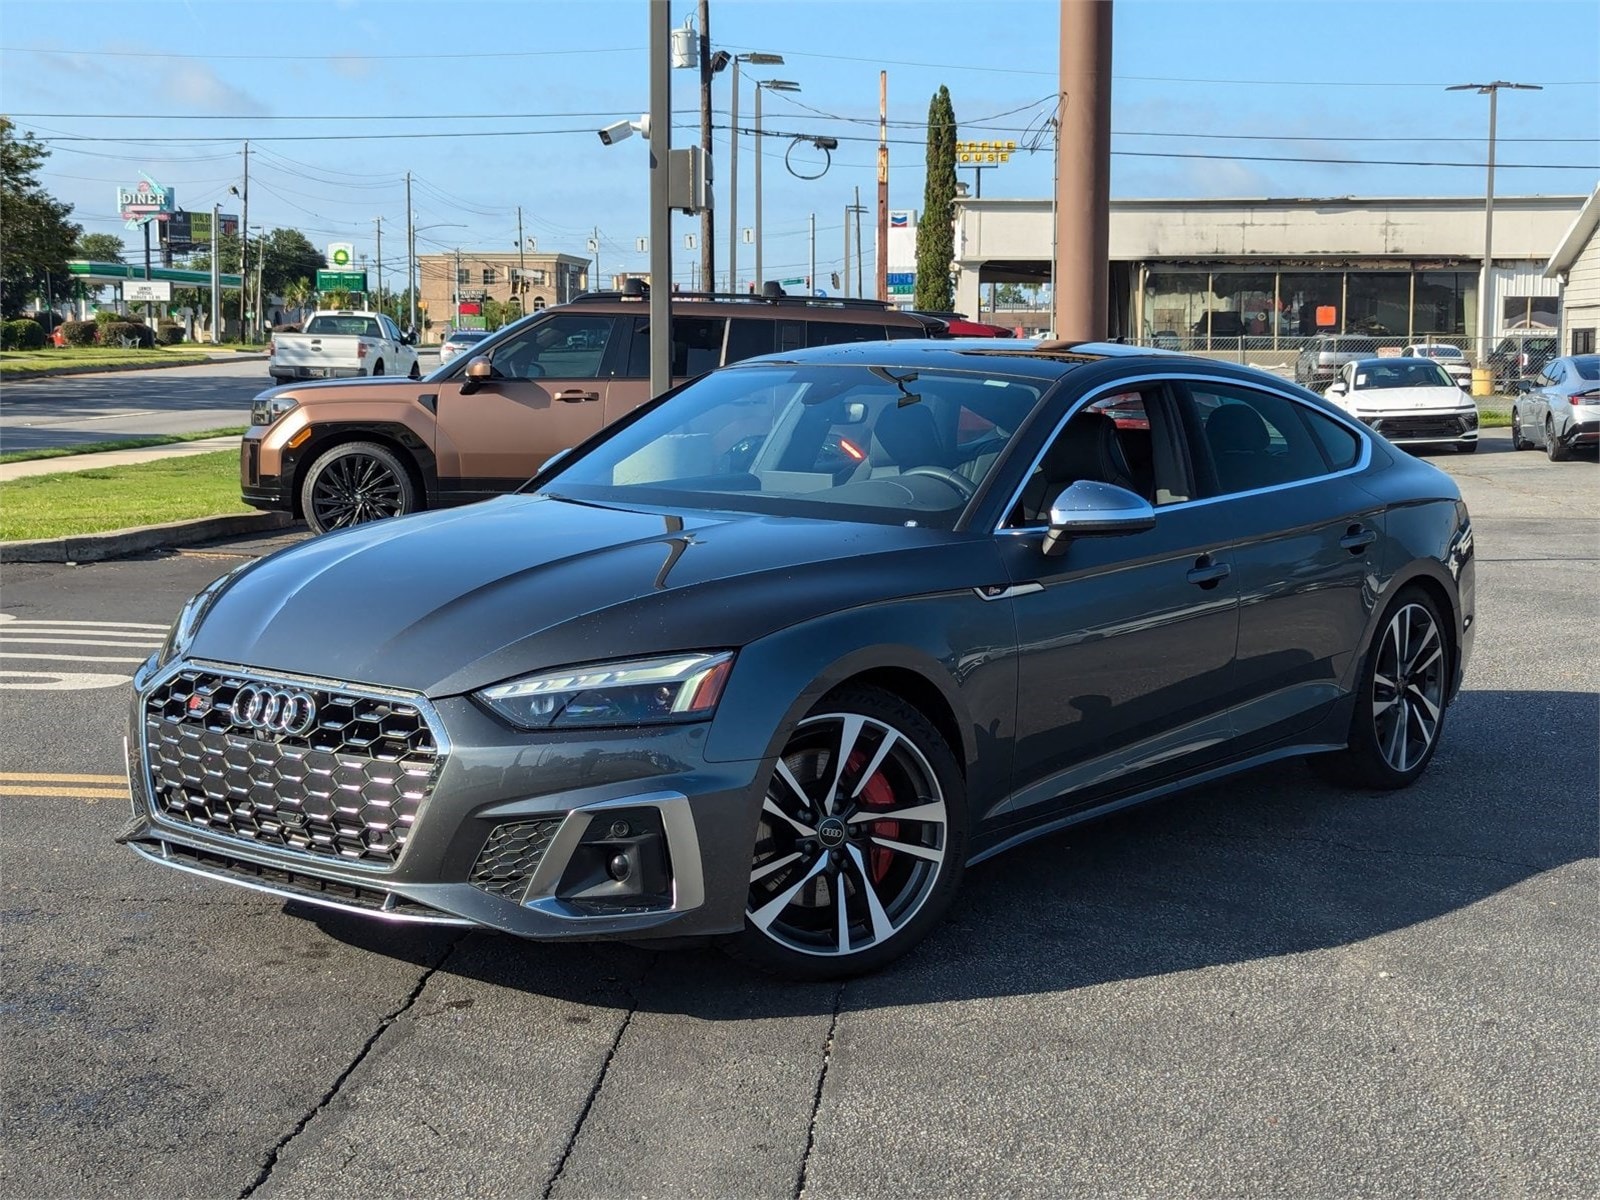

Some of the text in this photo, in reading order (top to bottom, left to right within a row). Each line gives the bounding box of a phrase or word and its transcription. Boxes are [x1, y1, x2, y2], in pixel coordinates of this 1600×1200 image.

[956, 142, 1014, 150] AFFLE
[961, 153, 1008, 162] OUSE
[122, 193, 166, 205] DINER
